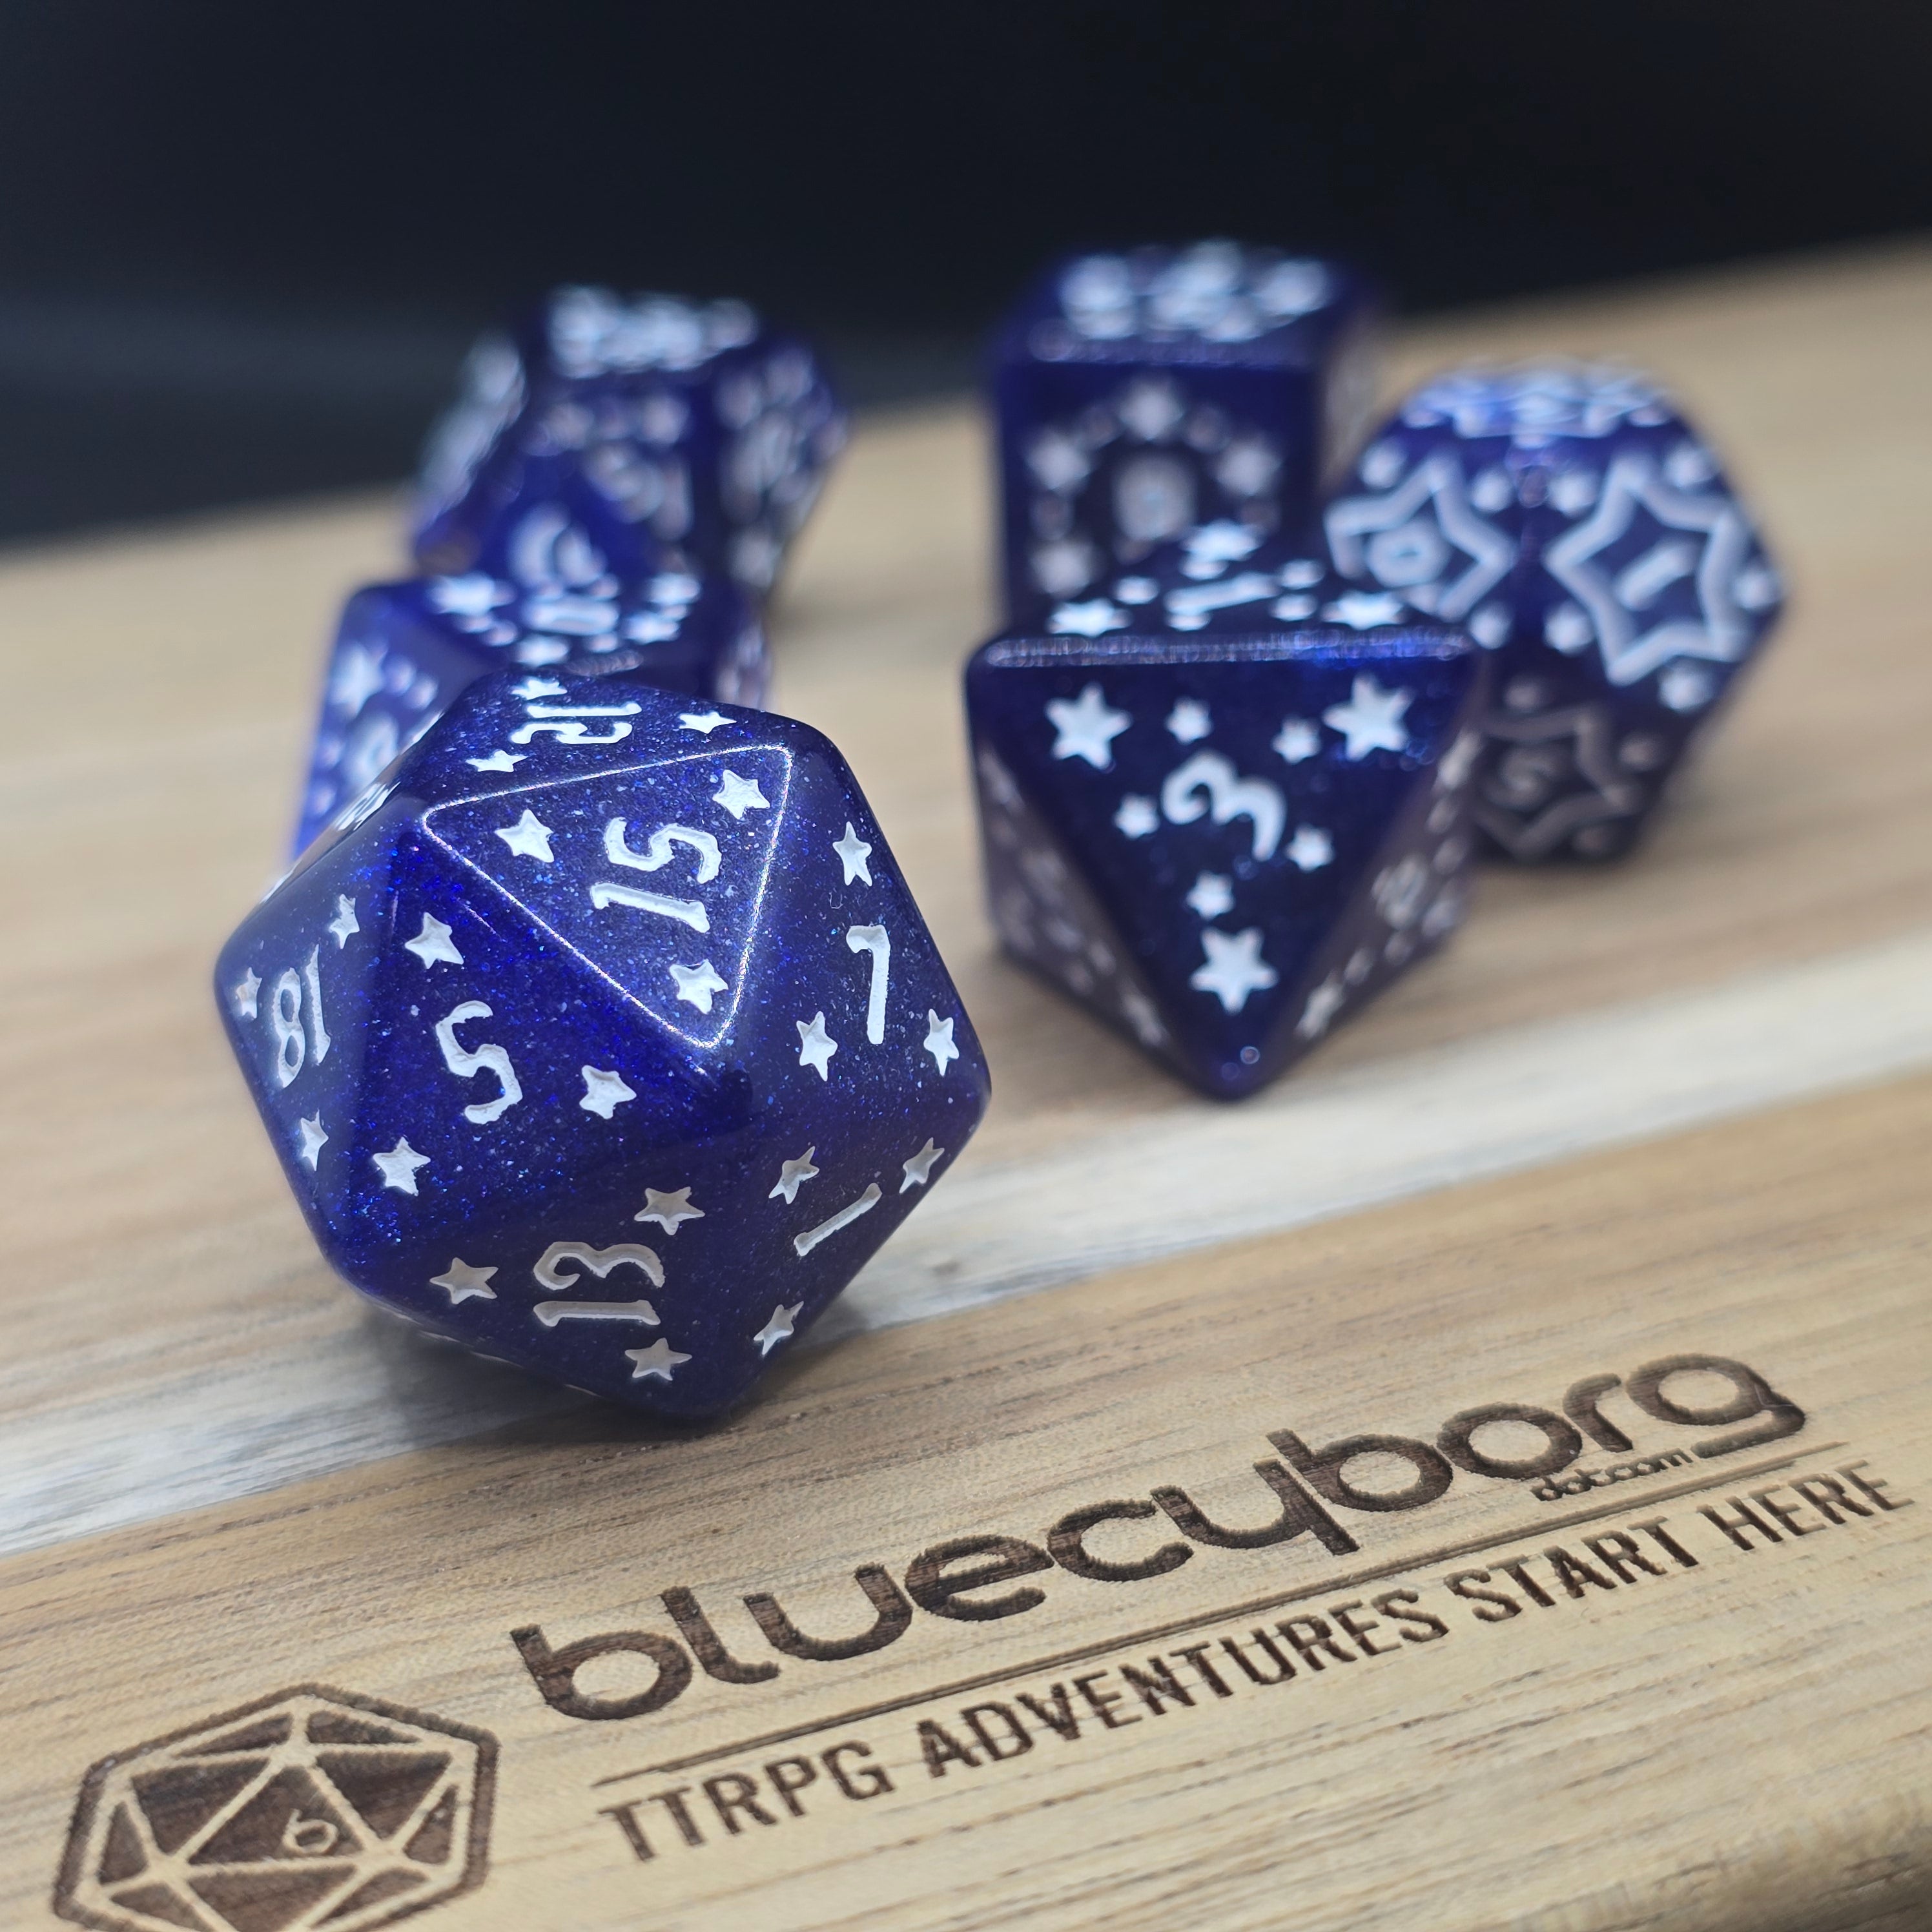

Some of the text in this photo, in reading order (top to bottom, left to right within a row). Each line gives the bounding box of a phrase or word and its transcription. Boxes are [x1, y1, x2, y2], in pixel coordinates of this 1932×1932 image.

[1162, 750, 1287, 863] 3
[590, 817, 722, 933] 15
[272, 943, 331, 1089] 18
[846, 924, 891, 1045] 7
[435, 1000, 522, 1124] 5
[793, 1182, 883, 1257] 1
[533, 1241, 666, 1327] 13
[509, 1353, 1806, 1721] bluecyborg
[598, 1459, 1916, 1862] TTRPG ADVENTURES START HERE
